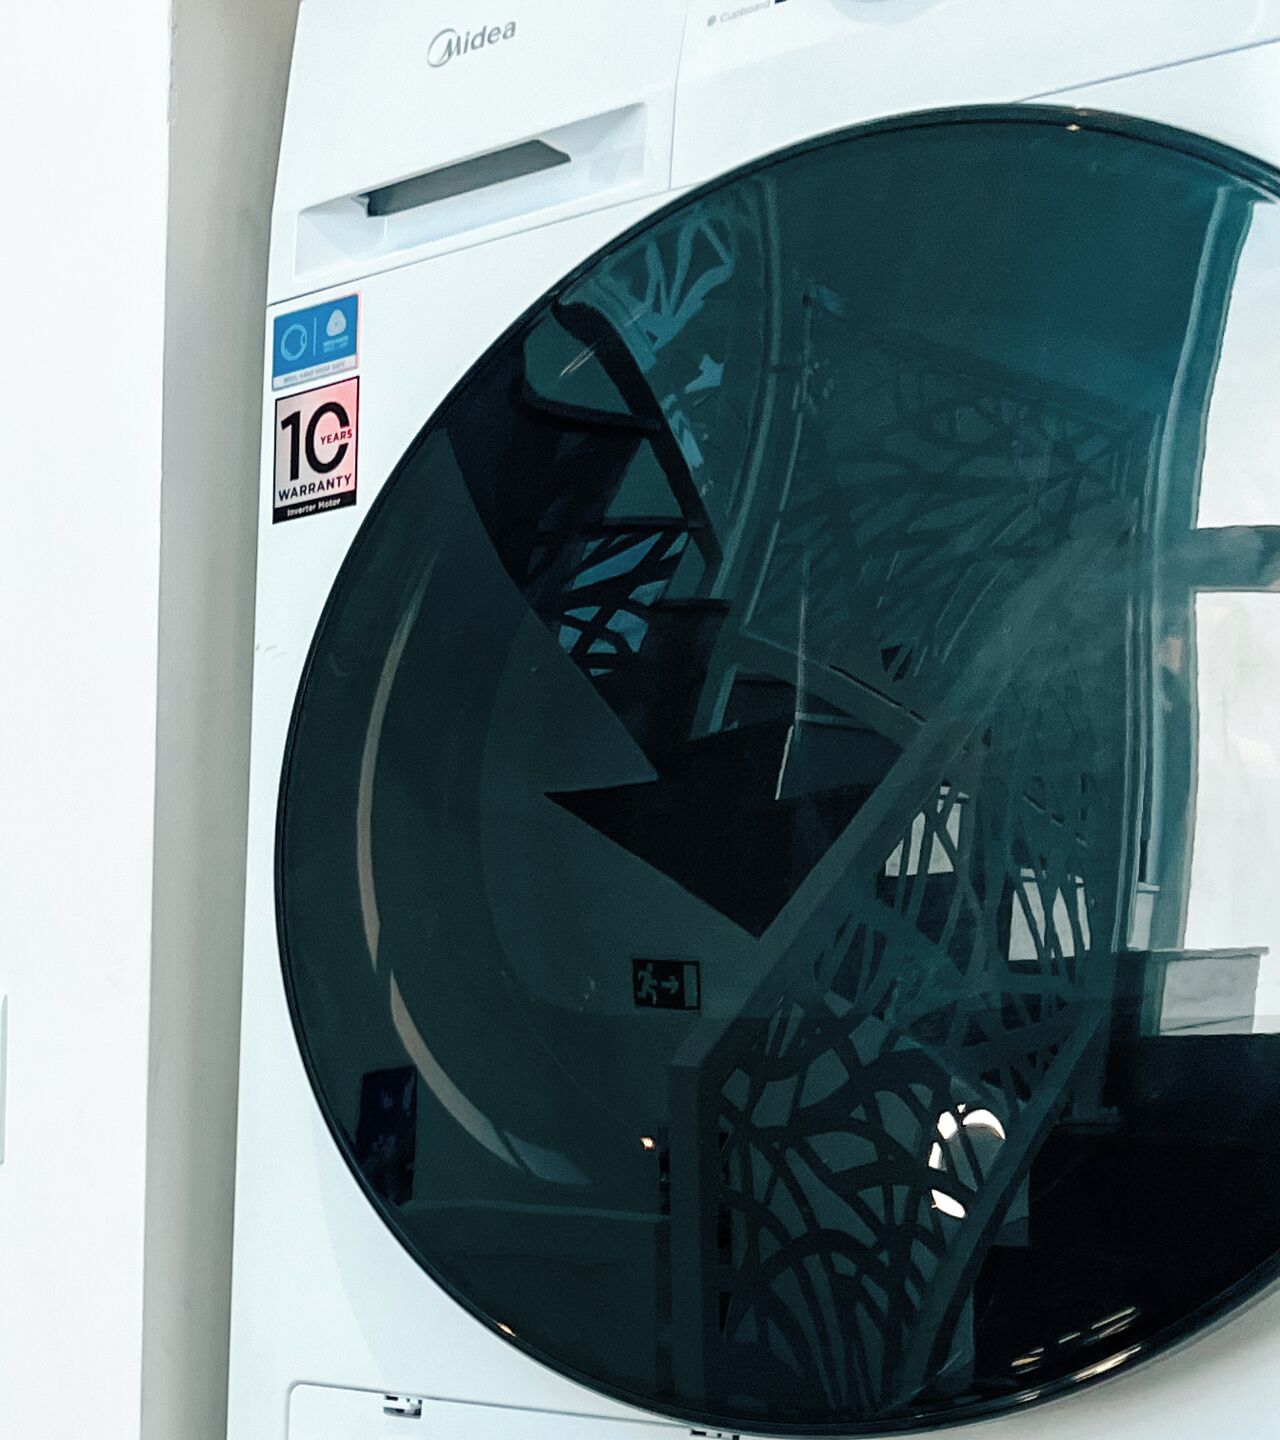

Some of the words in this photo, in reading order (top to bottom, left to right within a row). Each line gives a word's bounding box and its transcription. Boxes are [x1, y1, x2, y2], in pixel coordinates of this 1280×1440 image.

[426, 20, 517, 68] Midea
[320, 428, 353, 446] YEARS
[278, 473, 353, 502] WARRANTY
[287, 503, 316, 517] Inverter
[318, 498, 341, 510] Motor
